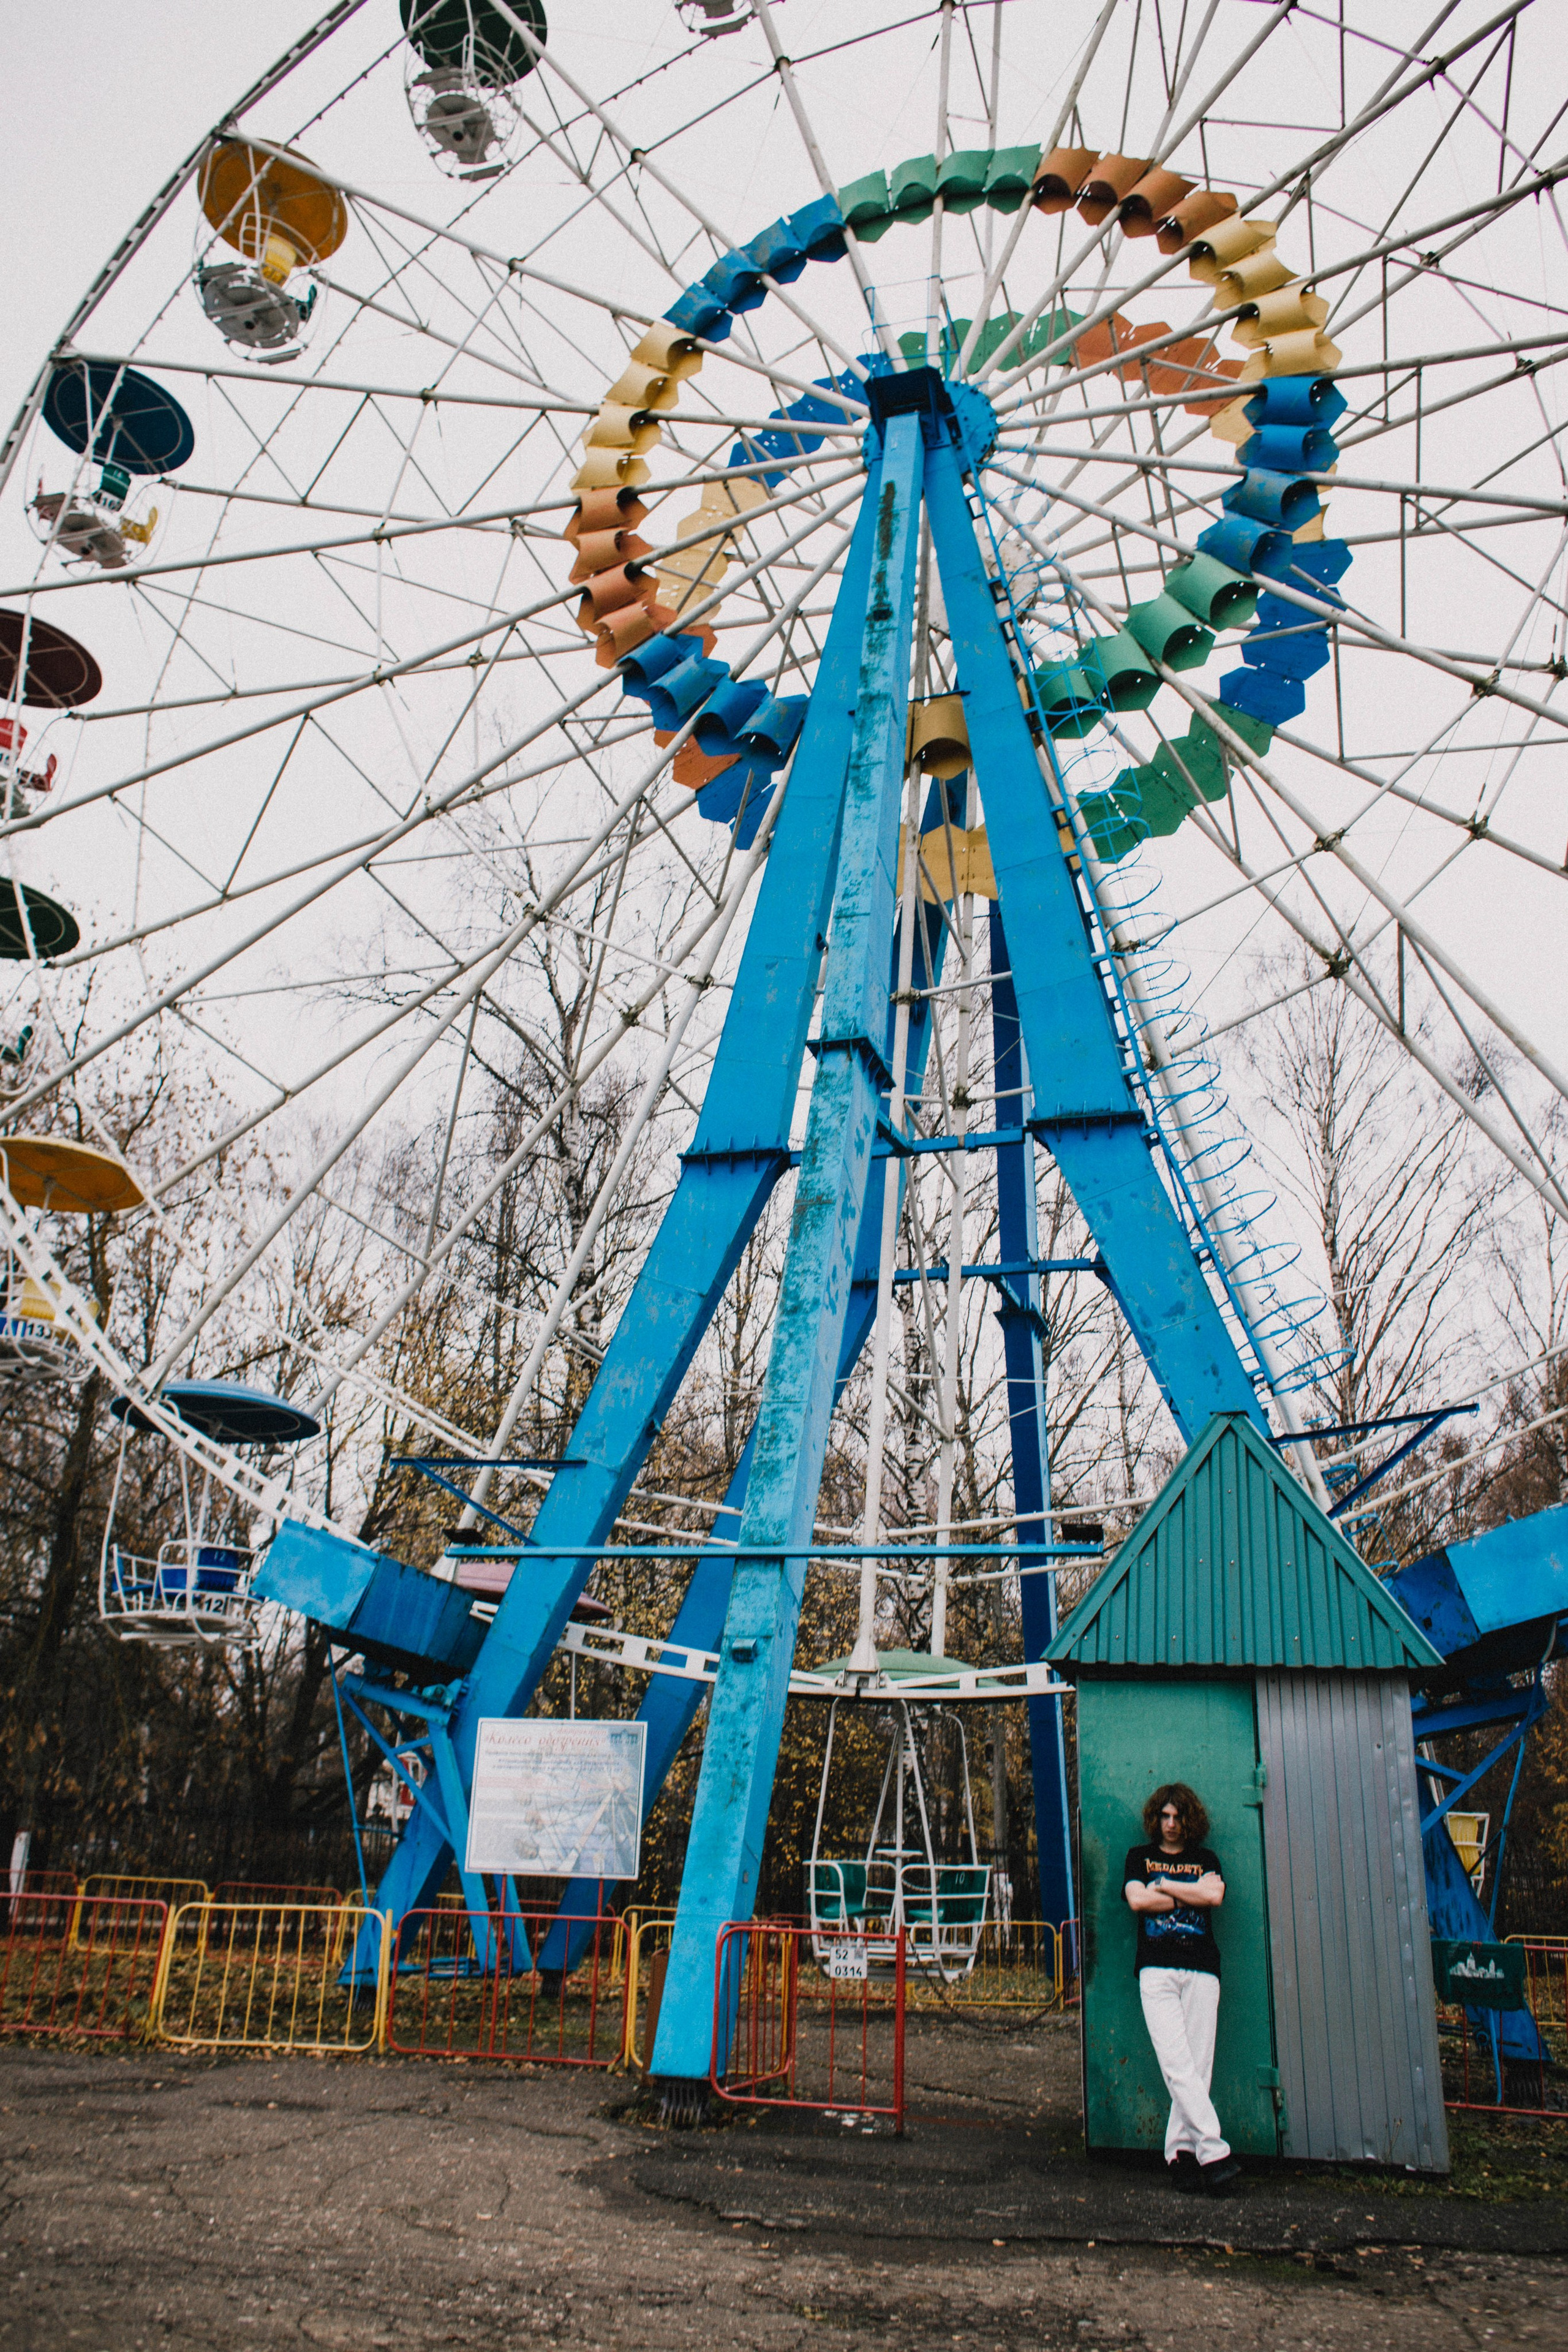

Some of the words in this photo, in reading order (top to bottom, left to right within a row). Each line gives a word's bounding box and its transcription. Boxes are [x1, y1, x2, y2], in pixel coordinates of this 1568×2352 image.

[28, 1323, 45, 1338] 13
[214, 1550, 227, 1562] 12
[205, 1597, 224, 1613] 12
[955, 1871, 965, 1885] 10
[835, 1948, 848, 1960] 52
[835, 1966, 862, 1977] 0314
